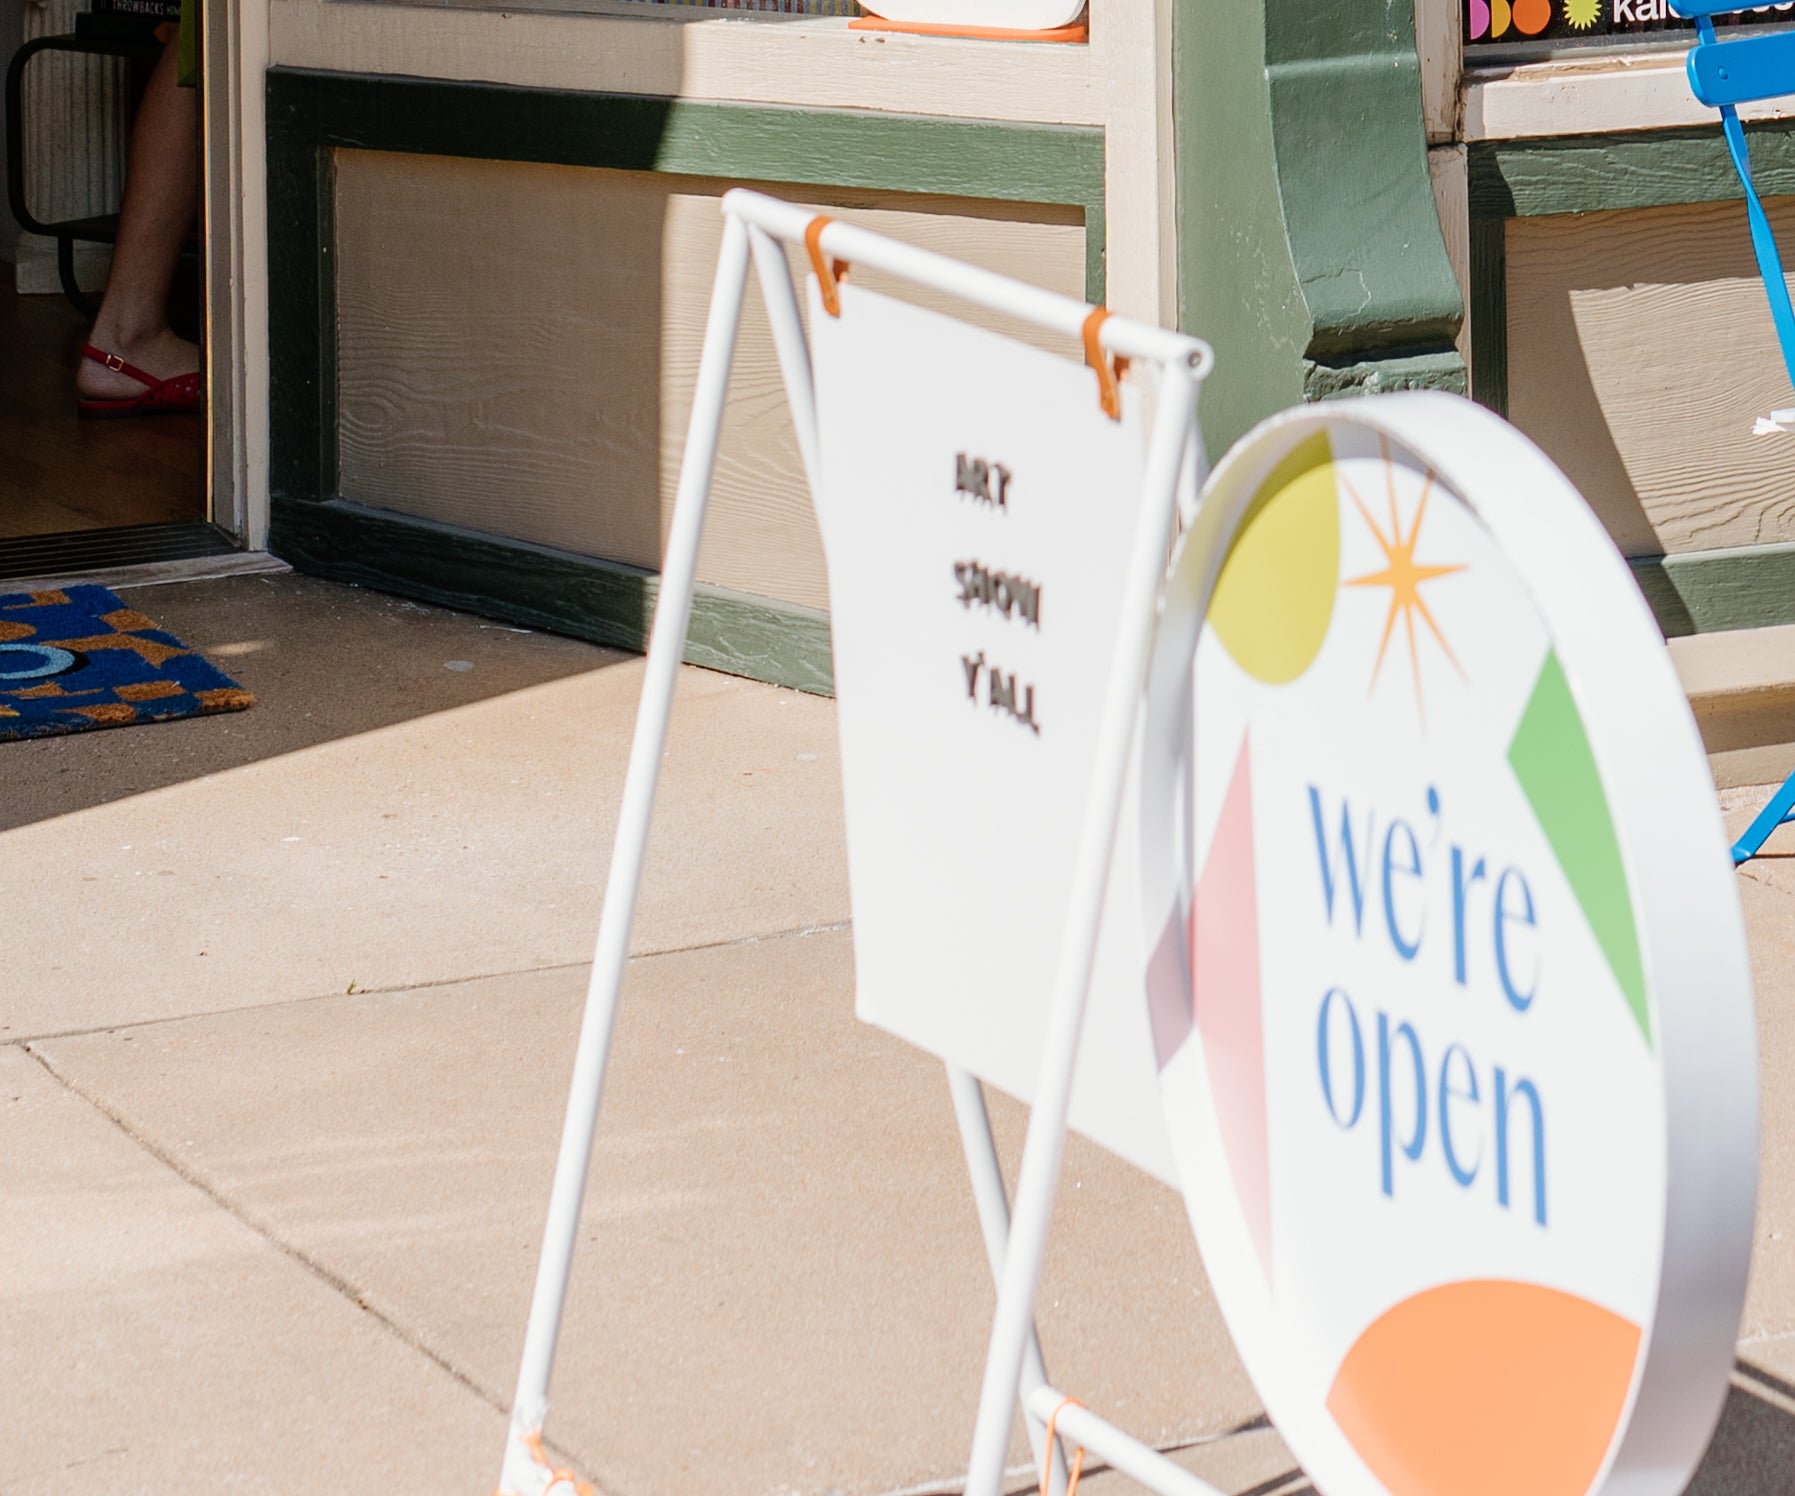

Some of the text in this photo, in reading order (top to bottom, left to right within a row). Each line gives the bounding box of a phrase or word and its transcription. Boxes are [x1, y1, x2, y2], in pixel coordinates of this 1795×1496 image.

[955, 450, 1013, 513] ART
[953, 558, 1043, 633] SHOW
[960, 649, 1041, 738] Y'ALL
[1306, 780, 1542, 1015] we're
[1315, 985, 1549, 1231] open
